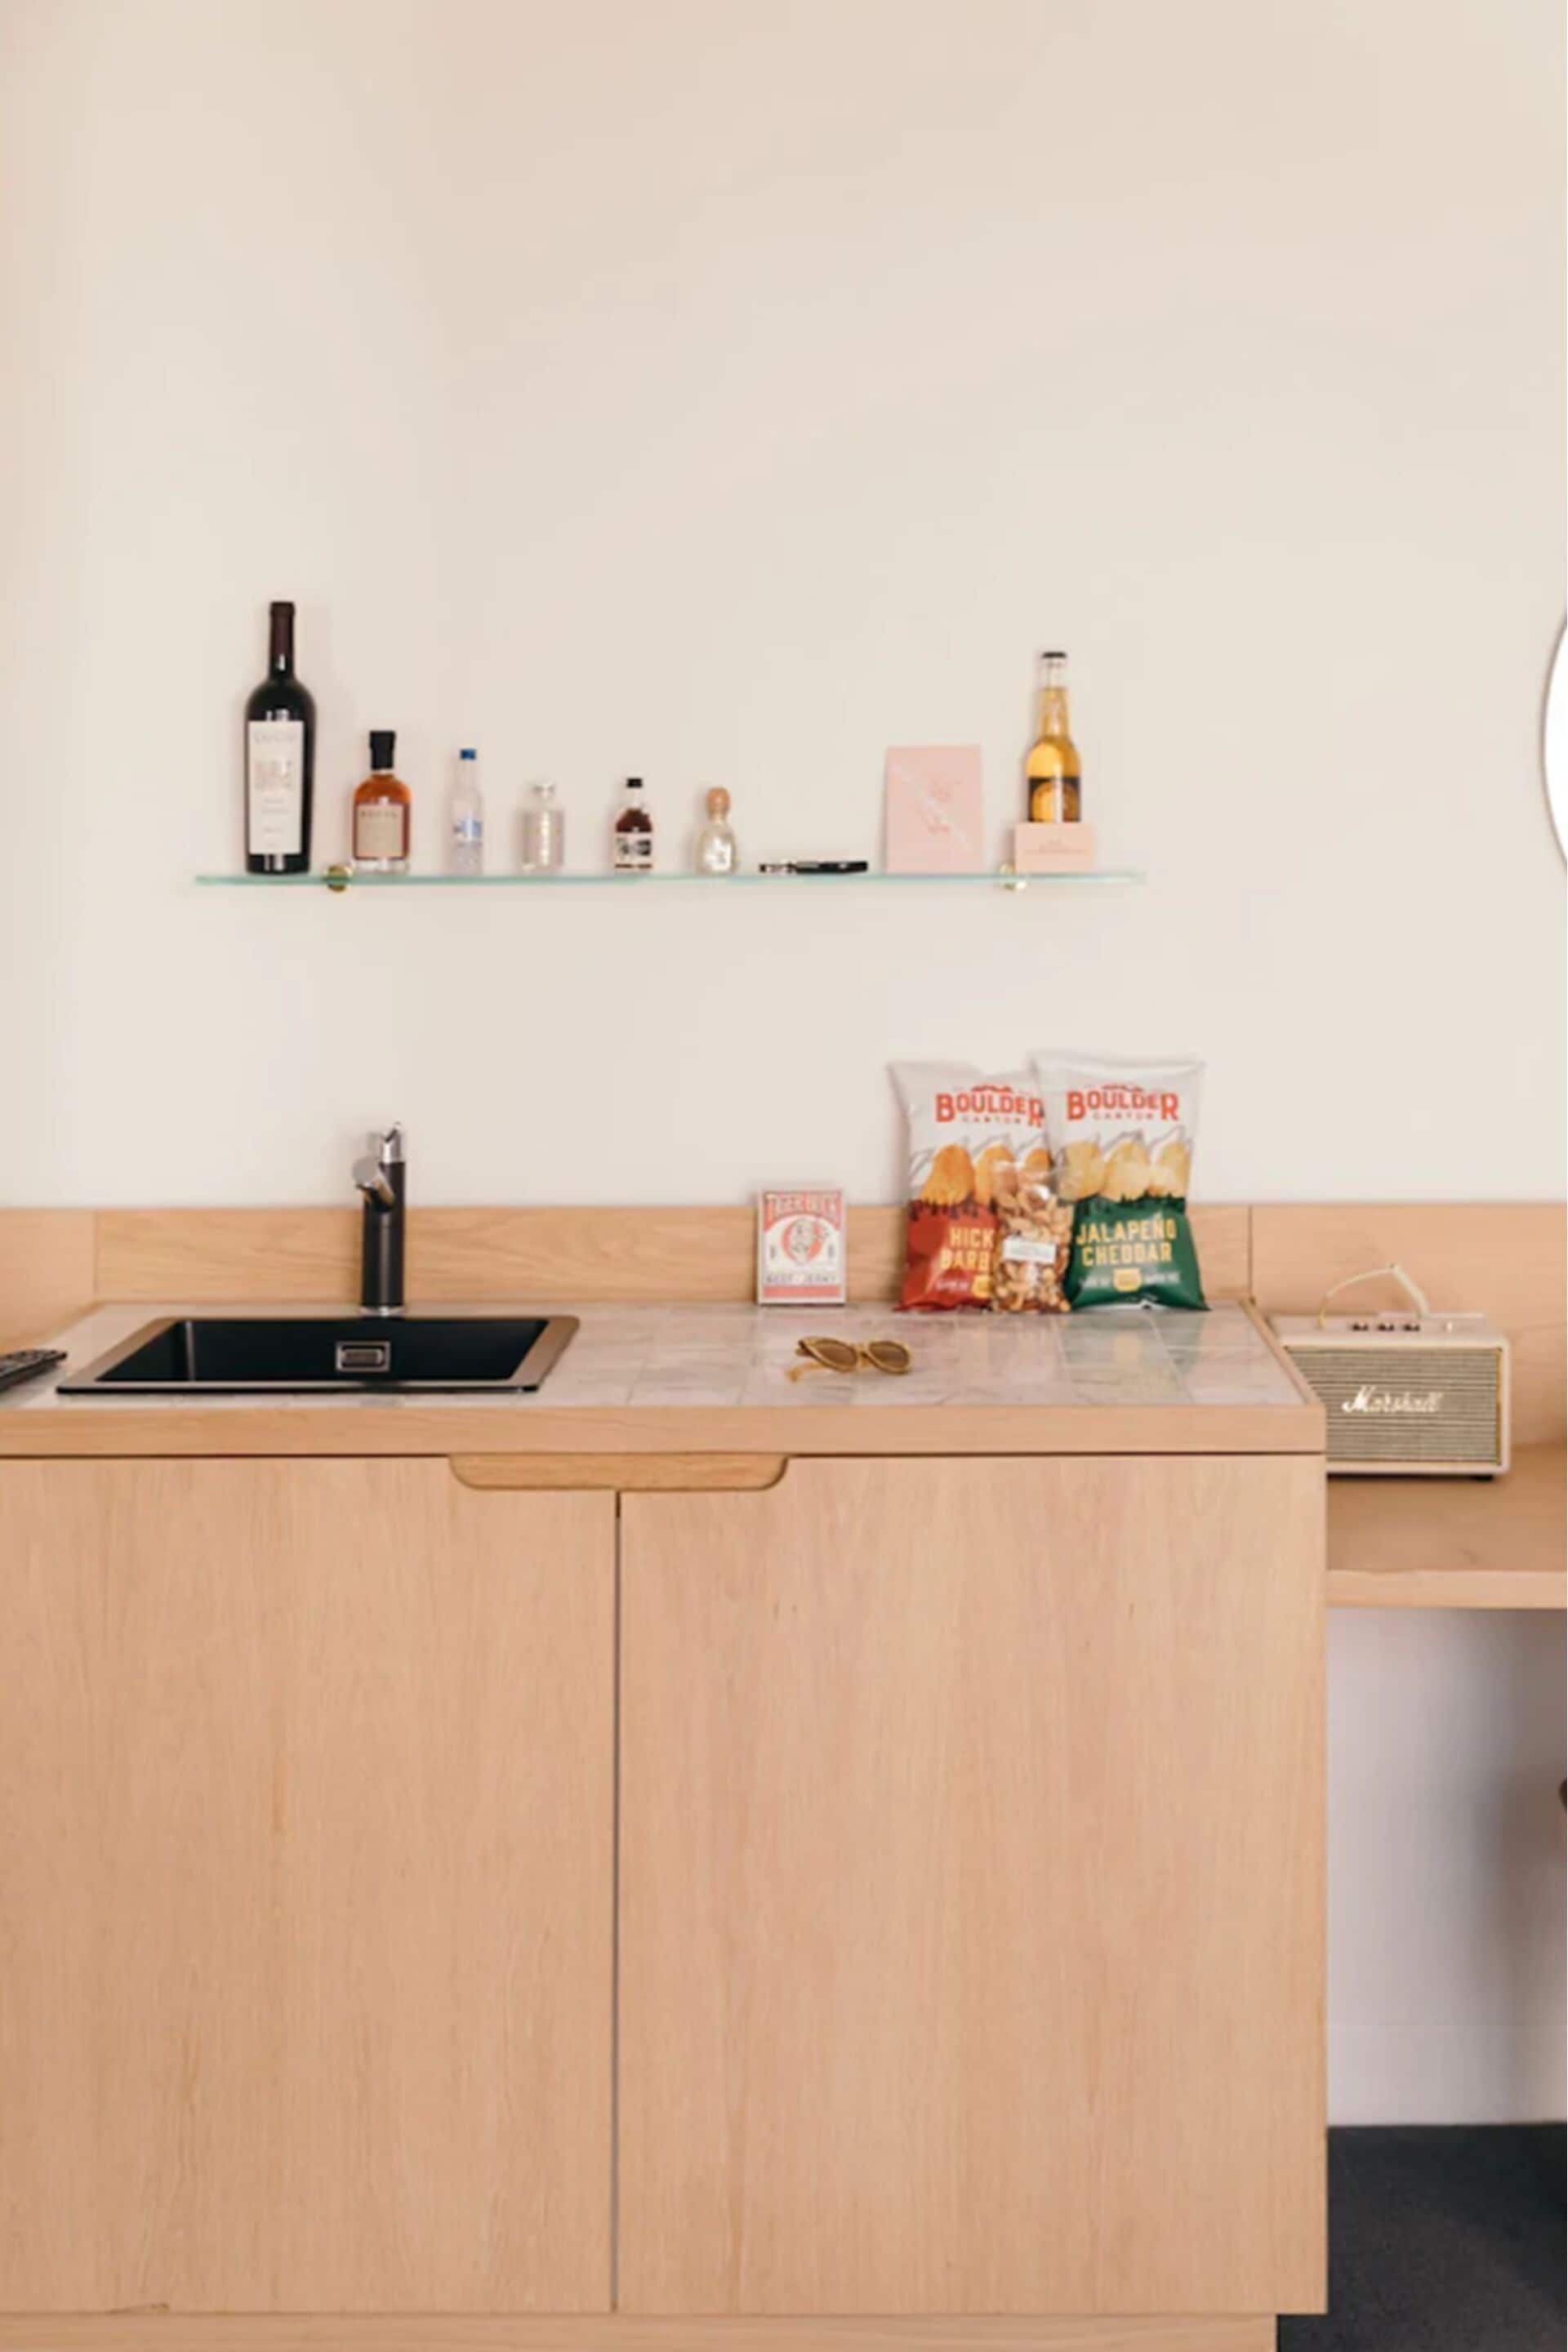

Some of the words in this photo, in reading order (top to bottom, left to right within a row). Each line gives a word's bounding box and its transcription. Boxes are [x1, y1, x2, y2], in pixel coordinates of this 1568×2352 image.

[936, 1094, 1044, 1128] BOULDER
[1066, 1090, 1179, 1121] BOULDER
[1082, 1241, 1172, 1267] CHEDDAR
[1341, 1385, 1444, 1414] Marshall
